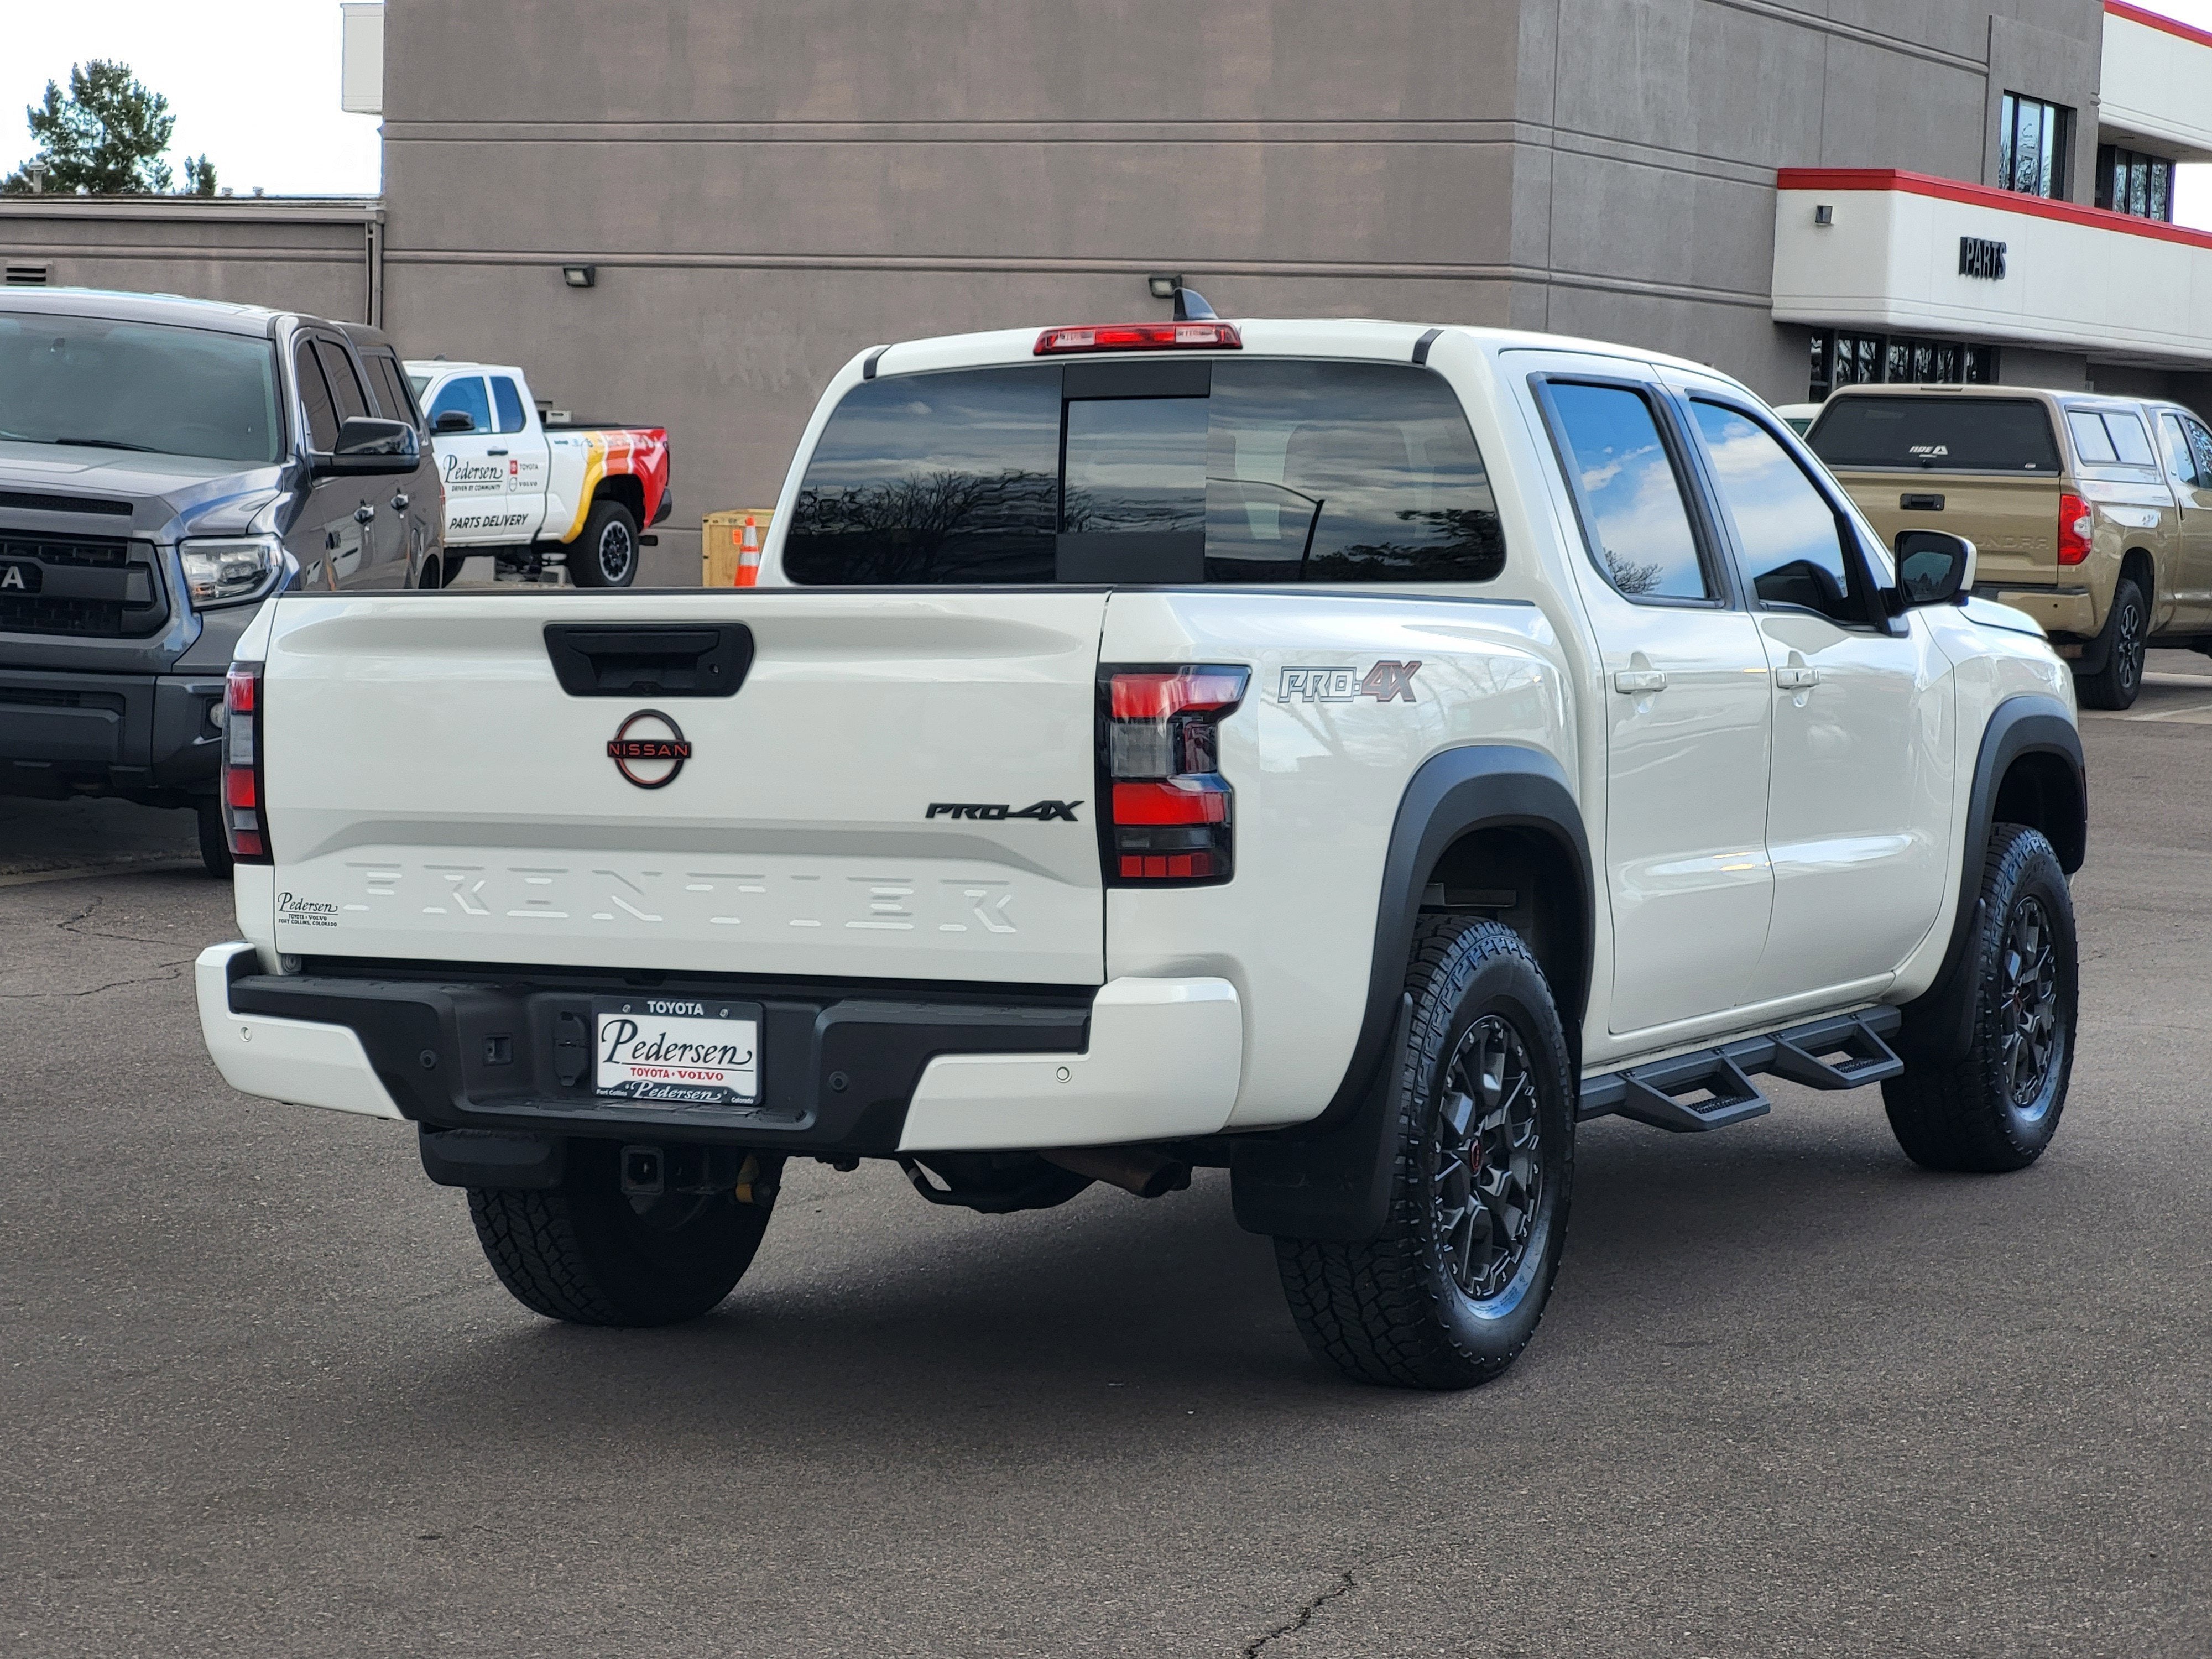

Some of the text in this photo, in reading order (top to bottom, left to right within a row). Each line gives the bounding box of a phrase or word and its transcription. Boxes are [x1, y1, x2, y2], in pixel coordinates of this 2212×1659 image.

[1965, 237, 2007, 280] PARTS
[444, 455, 503, 483] Pedersen
[449, 514, 529, 529] PARTS DELIVERY
[1975, 534, 2049, 549] UNDRA
[0, 565, 25, 589] A
[608, 744, 688, 756] NISSAN
[278, 892, 338, 912] Pedersen
[343, 862, 1018, 933] FRONTIER
[647, 1001, 703, 1015] TOYOTA
[601, 1019, 752, 1065] Pedersen
[630, 1068, 724, 1081] TOYOTA VOLVO
[630, 1079, 722, 1100] Pedersen
